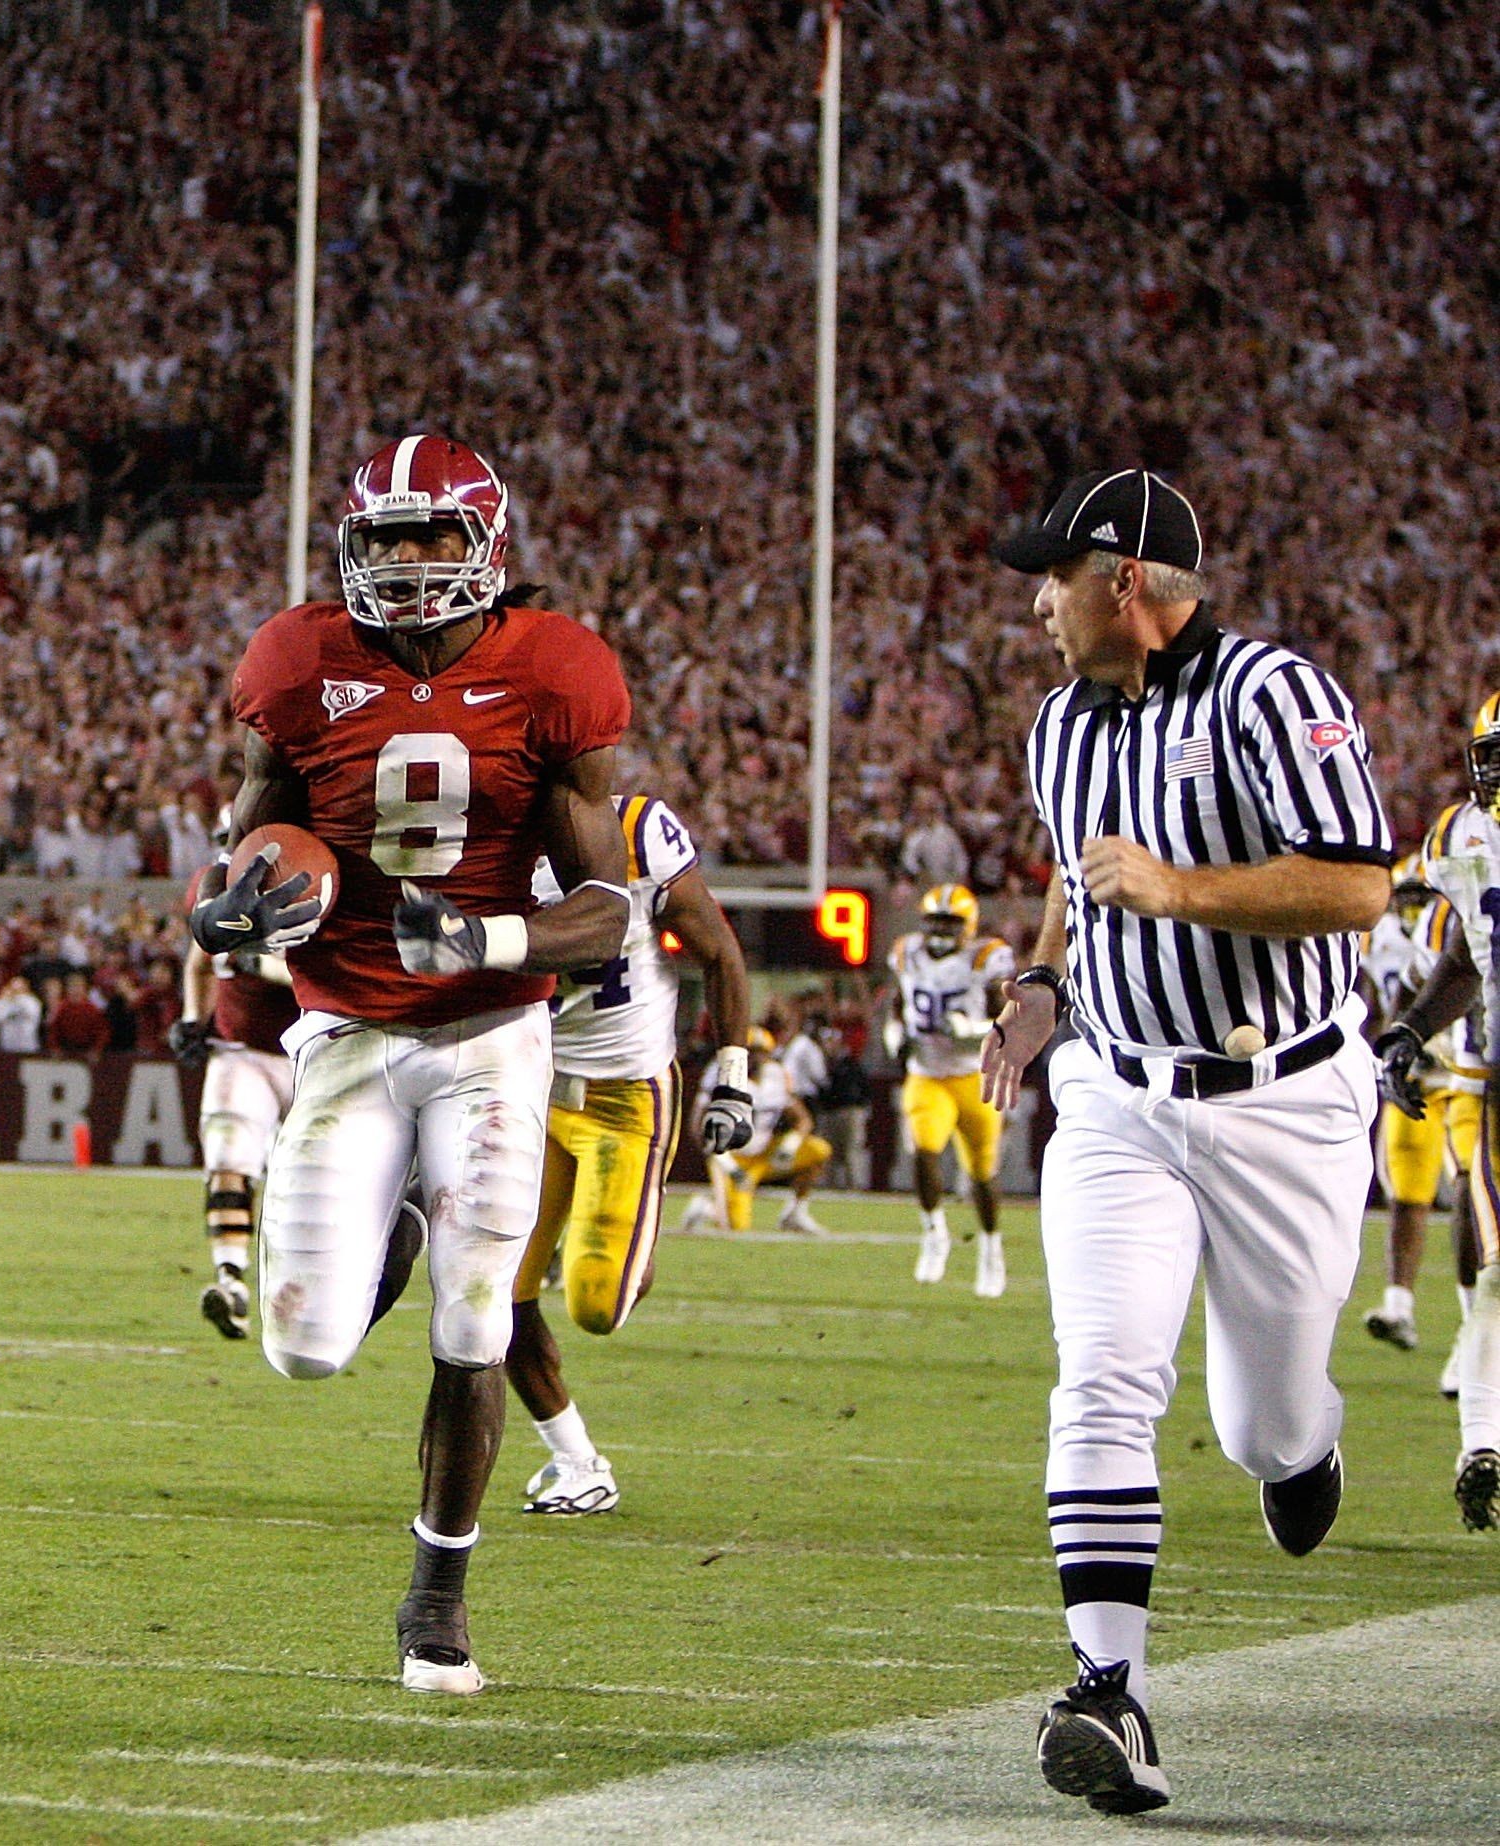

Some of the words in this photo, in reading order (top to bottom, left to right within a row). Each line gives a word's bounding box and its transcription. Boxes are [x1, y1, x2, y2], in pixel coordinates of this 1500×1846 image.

[369, 733, 470, 877] 8
[659, 814, 687, 856] 4
[817, 888, 870, 965] 9
